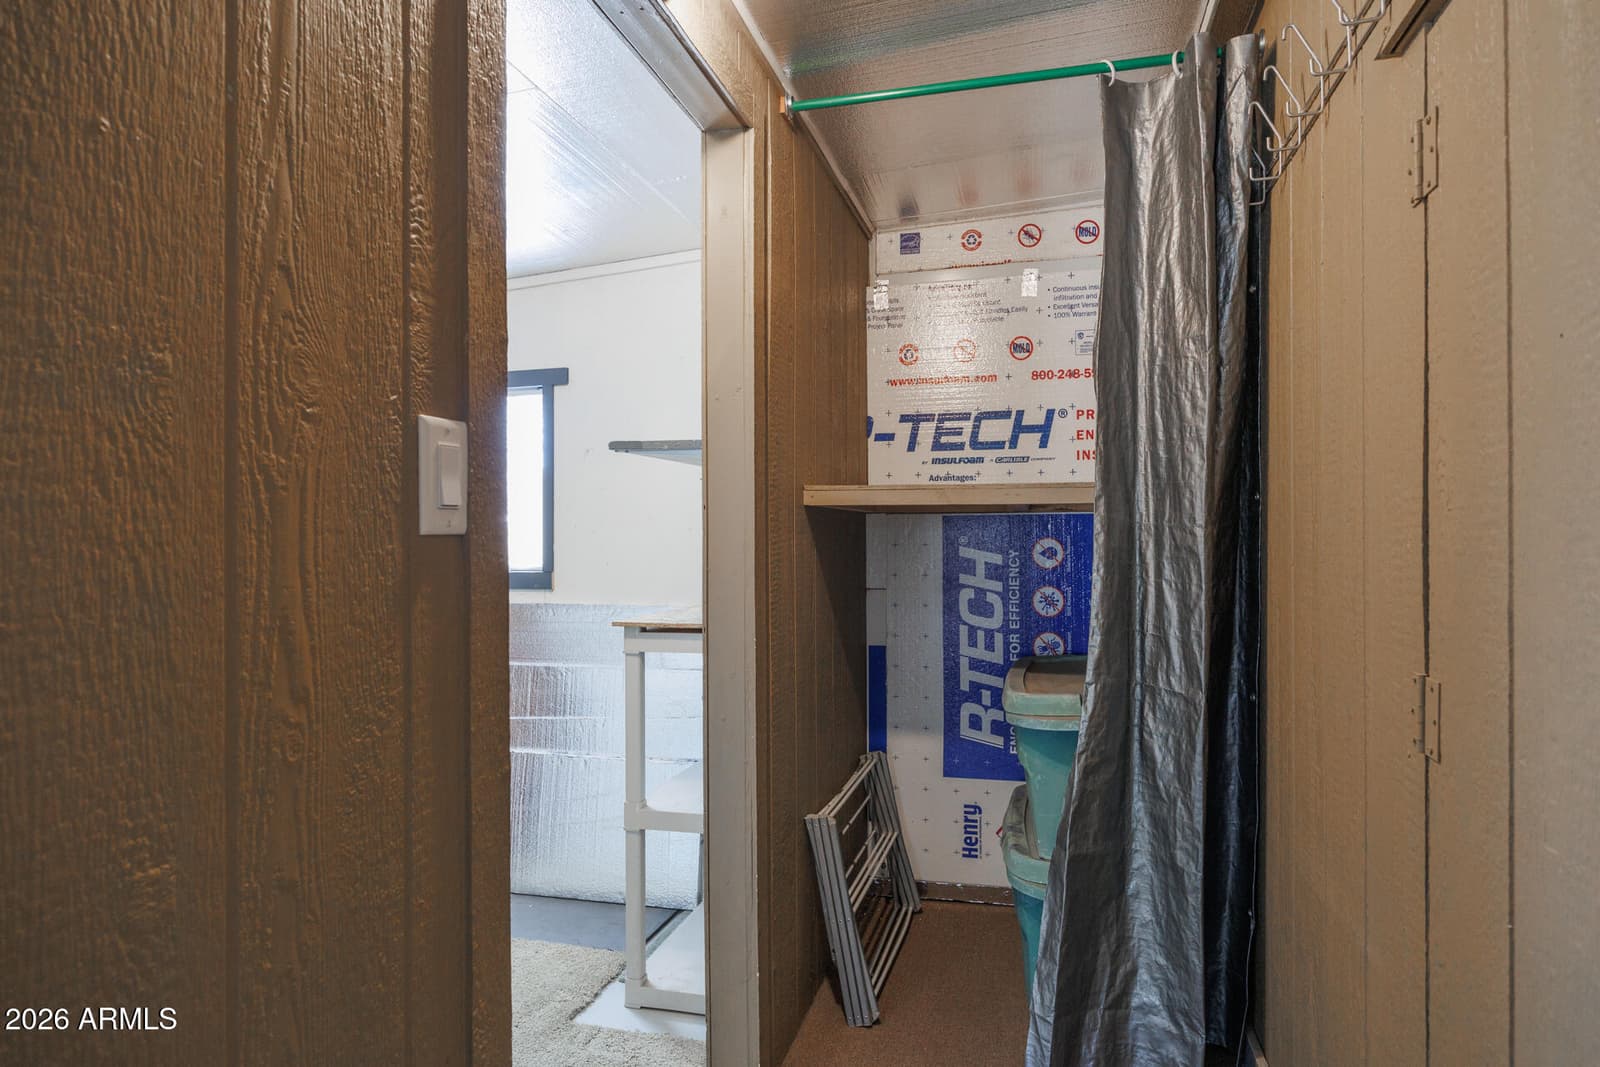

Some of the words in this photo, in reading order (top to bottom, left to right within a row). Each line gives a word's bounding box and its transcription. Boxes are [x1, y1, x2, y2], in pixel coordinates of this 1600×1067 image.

[1078, 226, 1097, 238] MOLD
[1012, 342, 1030, 353] MOLD
[1031, 368, 1094, 380] 800-248-5
[889, 374, 997, 387] www.insulfoam.com
[929, 474, 977, 483] Advantages:
[1009, 550, 1021, 629] EFFICIENCY
[1009, 634, 1021, 661] FOR
[962, 804, 983, 859] Henry
